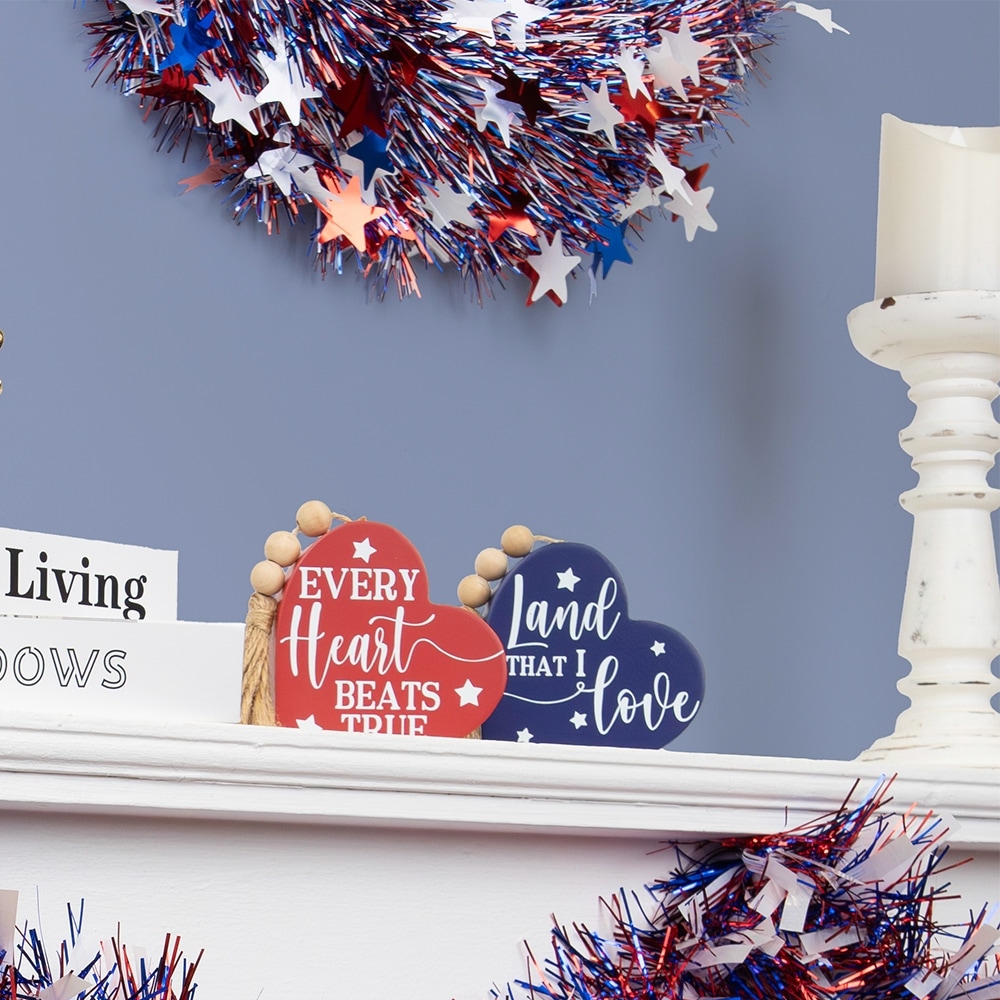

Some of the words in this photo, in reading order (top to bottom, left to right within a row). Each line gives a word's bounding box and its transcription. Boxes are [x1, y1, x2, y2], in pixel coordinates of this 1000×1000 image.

[5, 547, 148, 620] Living
[298, 566, 421, 601] EVERY
[506, 573, 622, 651] Land
[279, 601, 438, 690] Heart
[505, 655, 568, 678] THAT
[575, 648, 588, 678] I
[334, 679, 442, 711] BEATS
[591, 655, 701, 736] love
[340, 713, 429, 737] TRUE
